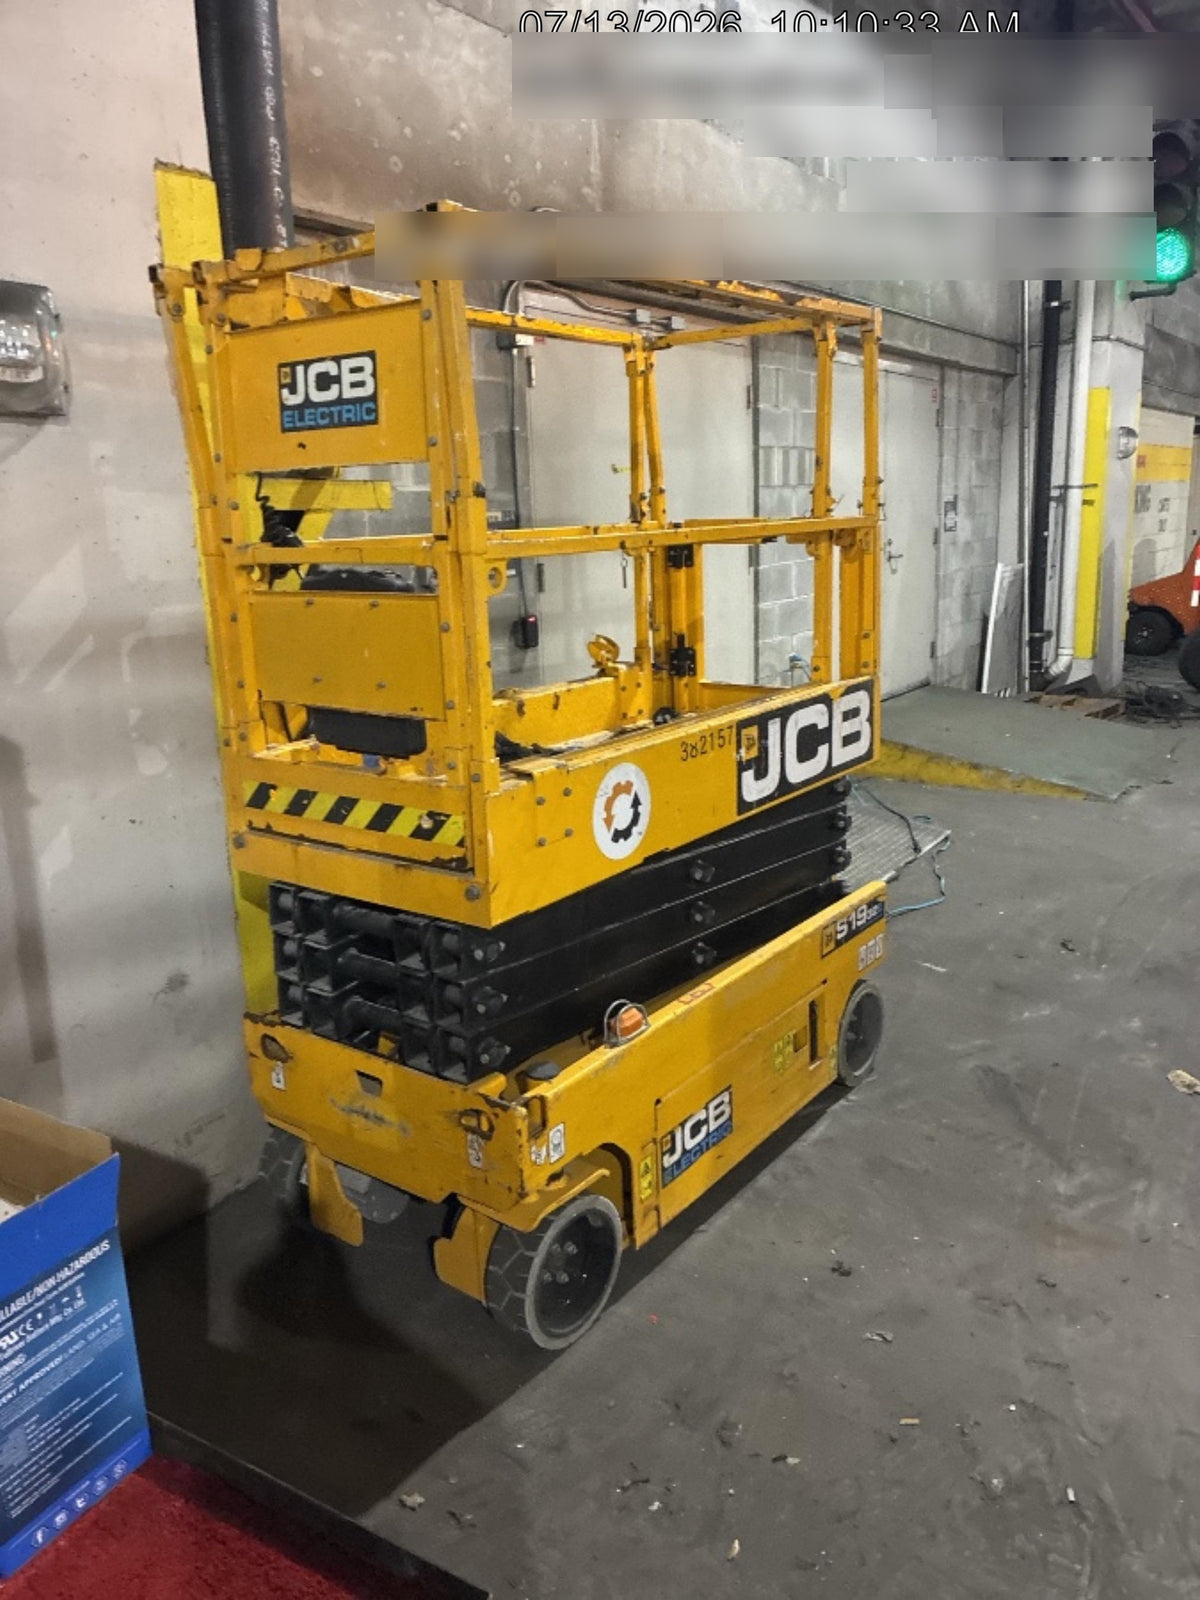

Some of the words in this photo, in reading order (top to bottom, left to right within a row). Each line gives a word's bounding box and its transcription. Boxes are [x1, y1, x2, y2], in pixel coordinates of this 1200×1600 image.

[281, 356, 376, 406] JCB
[282, 402, 377, 429] ELECTRIC
[741, 690, 872, 803] JCB
[662, 1090, 731, 1170] JCB
